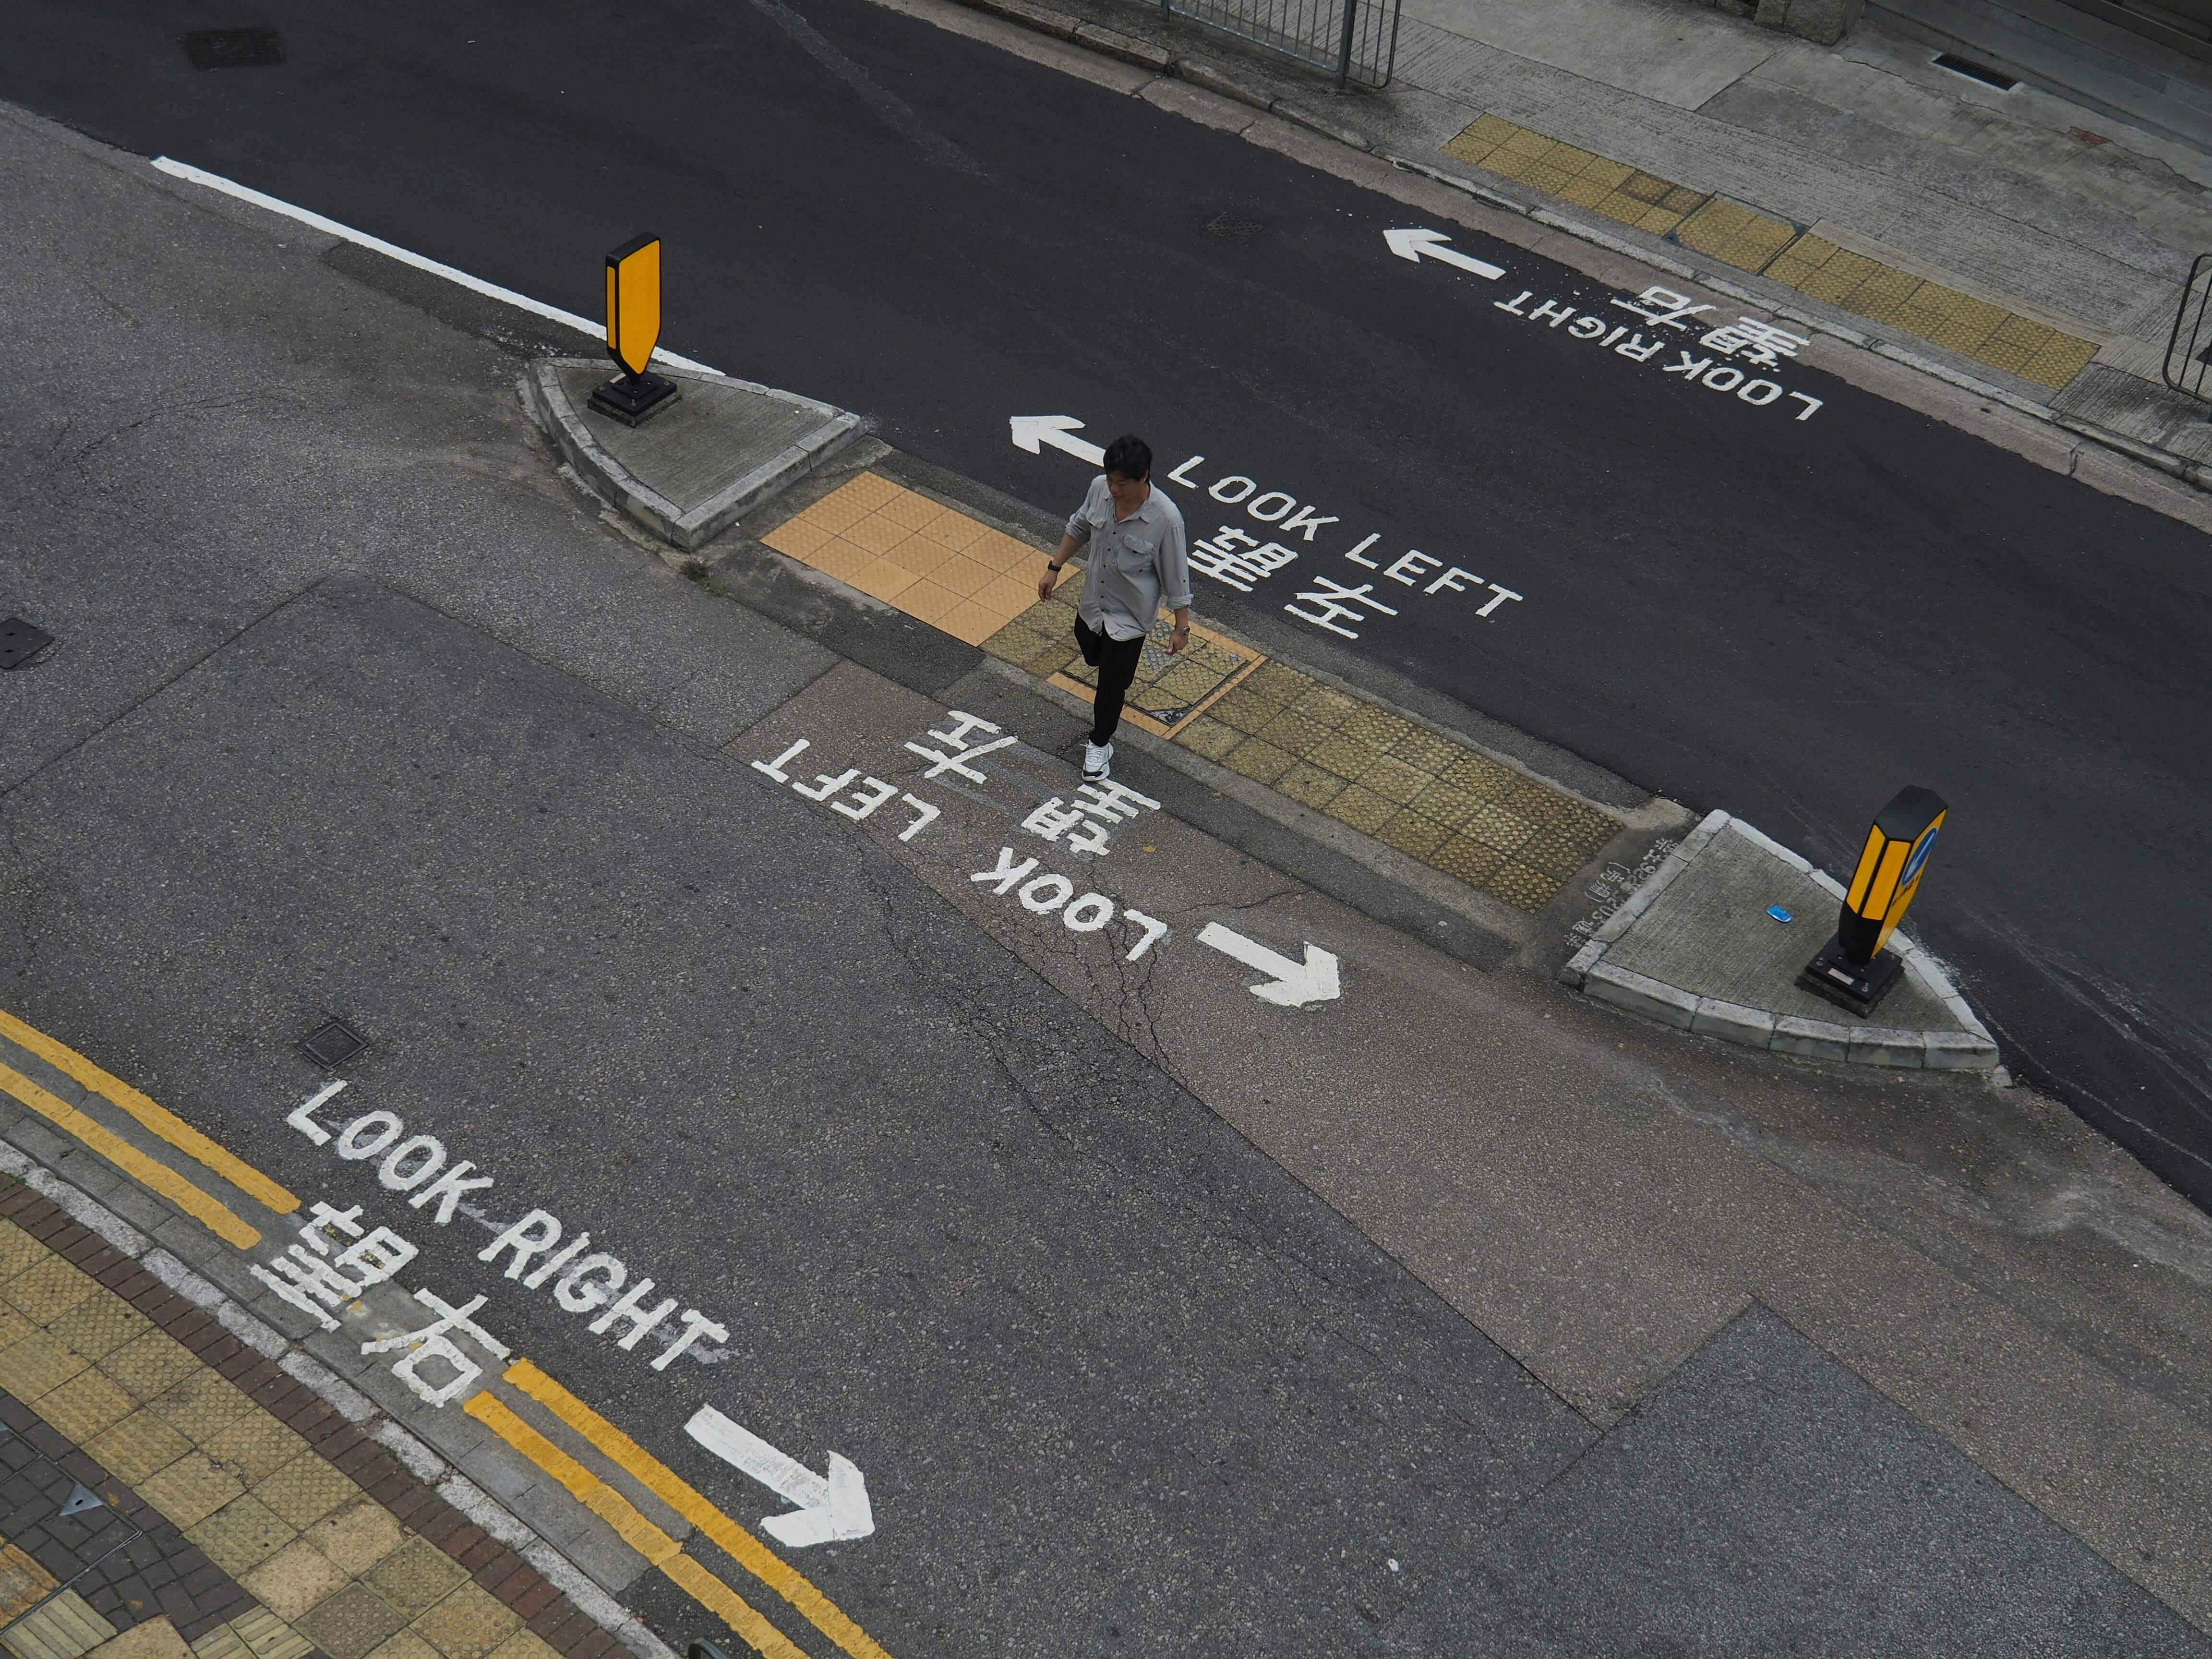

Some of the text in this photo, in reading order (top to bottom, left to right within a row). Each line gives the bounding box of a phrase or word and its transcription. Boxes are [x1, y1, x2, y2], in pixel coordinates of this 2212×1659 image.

[1495, 291, 1823, 420] LOOK RIGHT
[1611, 287, 1810, 366] 望右
[1168, 456, 1523, 617] LOOK LEFT
[1188, 526, 1398, 639] 望左
[751, 739, 1167, 962] LOOK LEFT
[903, 710, 1161, 856] 望左
[288, 1081, 729, 1370] LOOK RIGHT
[251, 1201, 510, 1407] 望右
